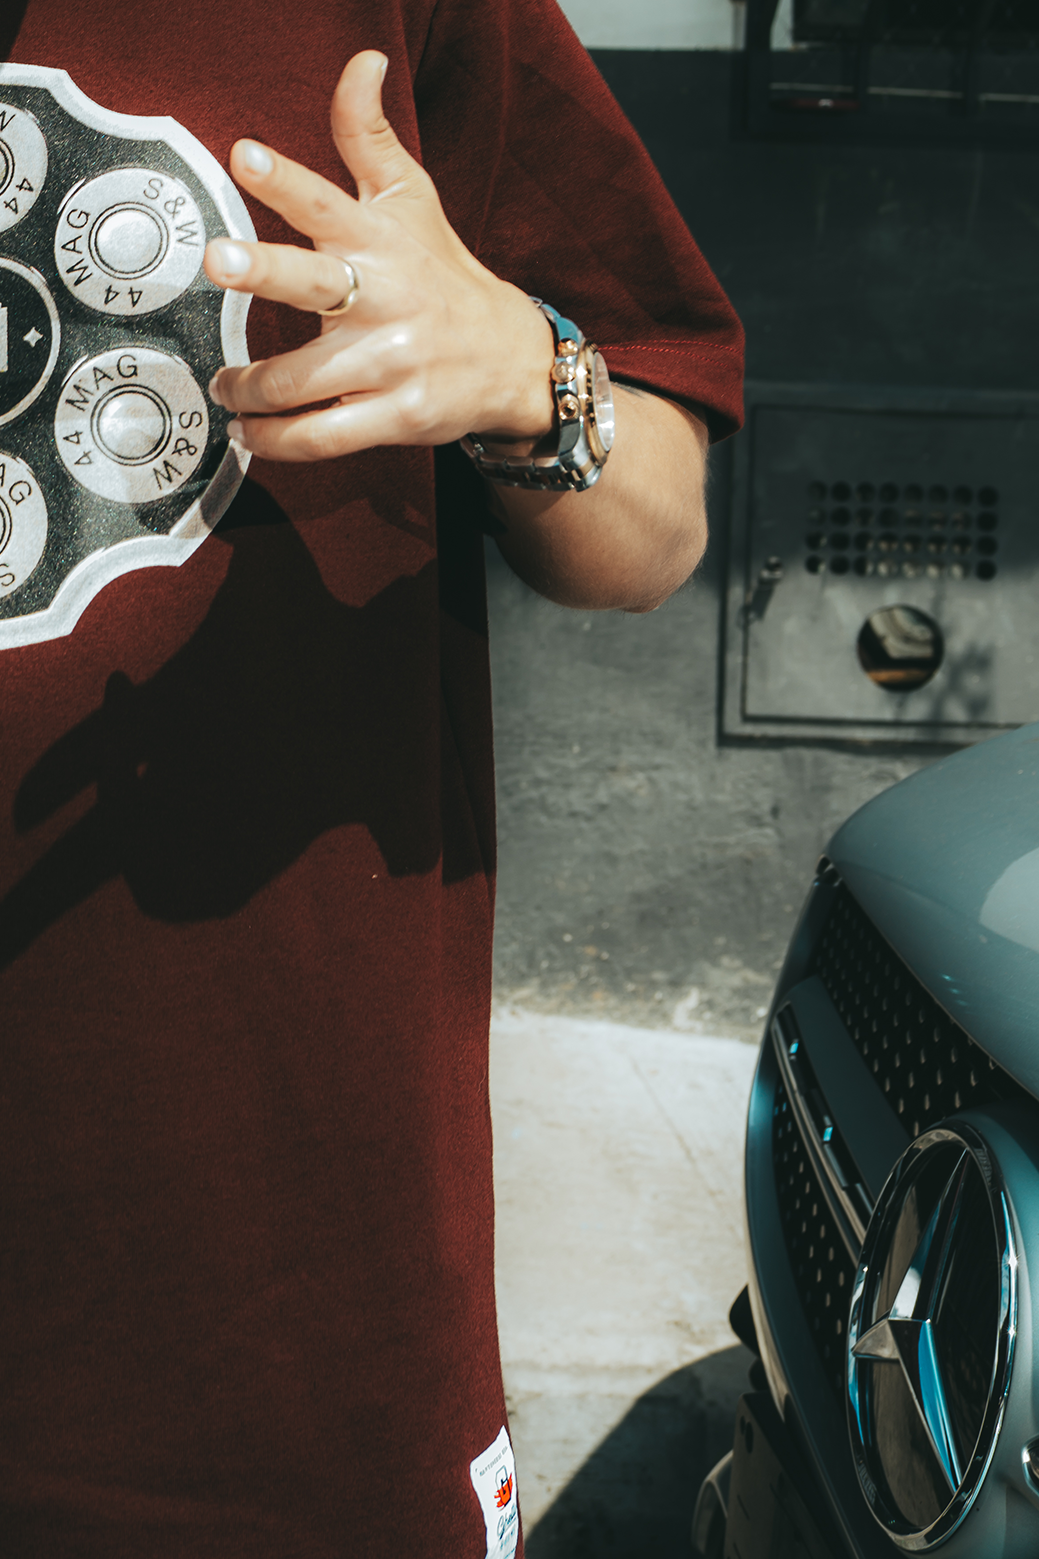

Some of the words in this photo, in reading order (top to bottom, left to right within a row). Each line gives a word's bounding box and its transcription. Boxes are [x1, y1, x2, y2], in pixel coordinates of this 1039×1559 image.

[3, 177, 34, 215] 44
[143, 178, 199, 246] S&W
[61, 208, 93, 287] MAG
[104, 284, 143, 308] 44
[65, 354, 138, 412] MAG
[62, 430, 92, 465] 44
[153, 410, 203, 490] S&W
